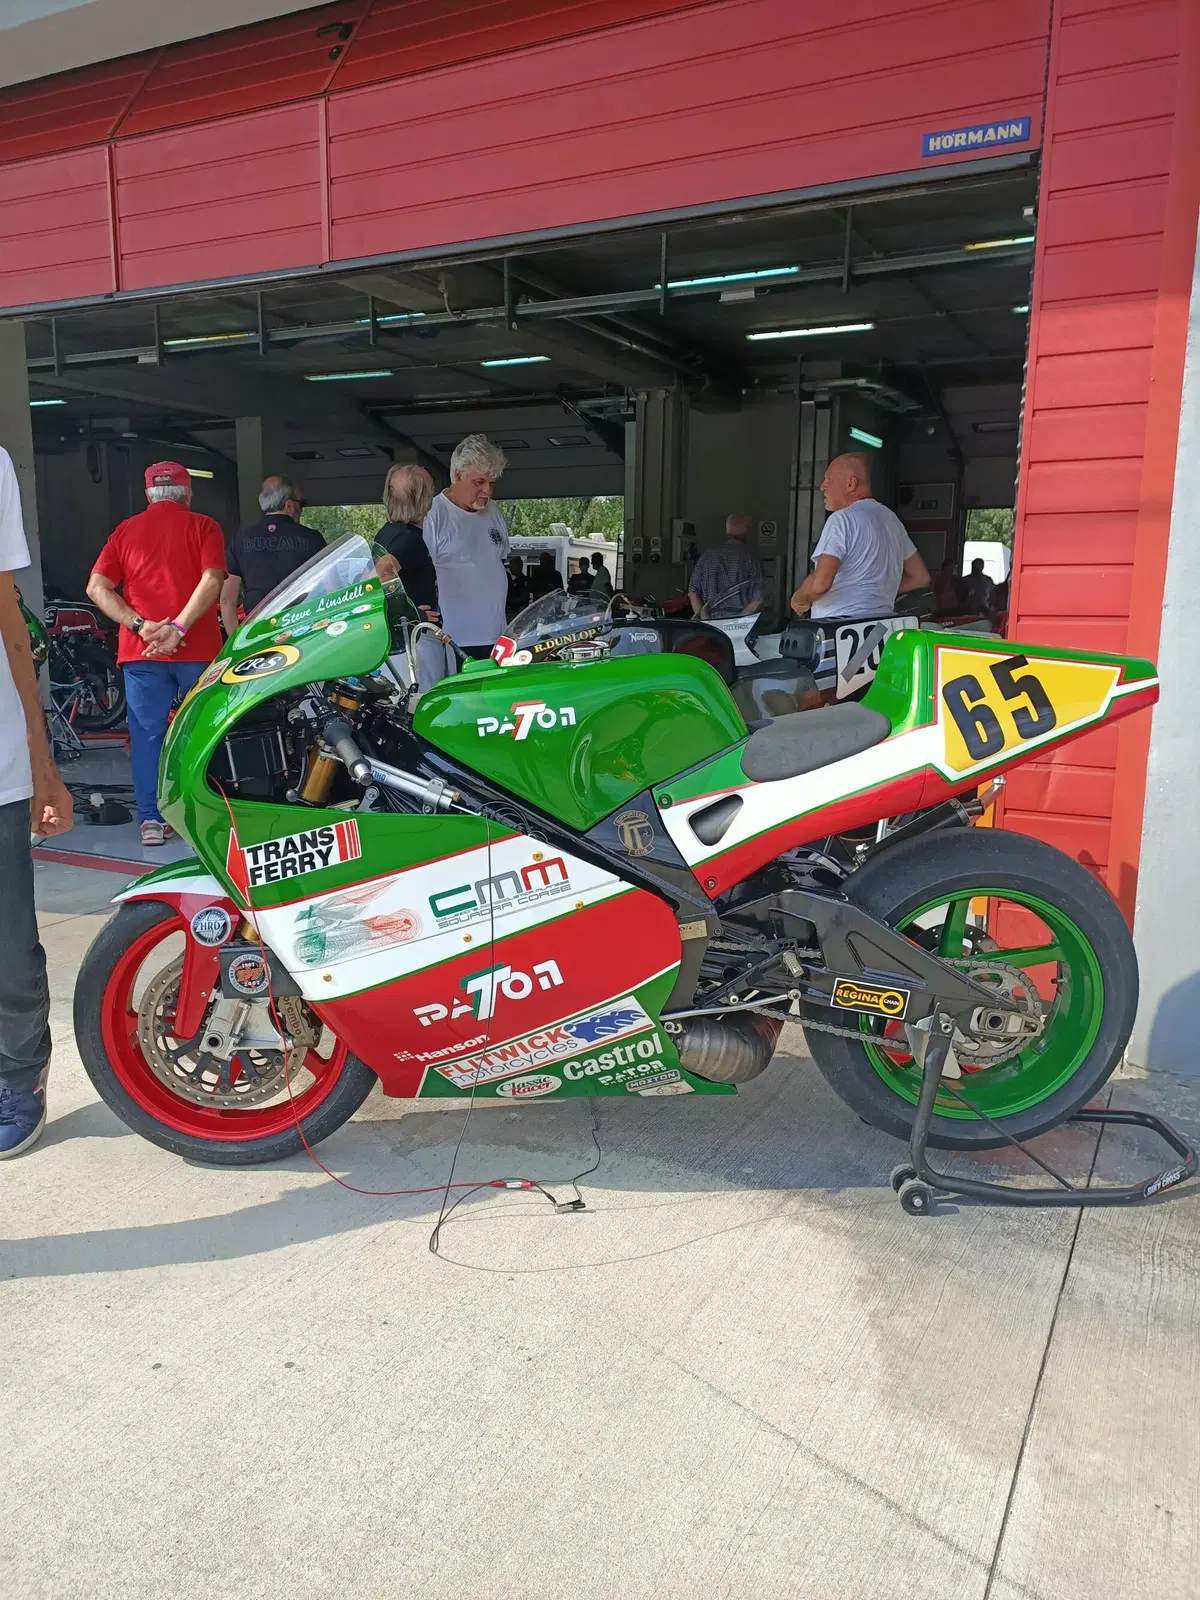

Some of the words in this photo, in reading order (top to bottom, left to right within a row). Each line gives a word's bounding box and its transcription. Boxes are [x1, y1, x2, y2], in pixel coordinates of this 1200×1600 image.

[281, 608, 312, 627] Steve
[316, 584, 364, 613] Linsdell
[533, 628, 597, 653] R.DUNLOP
[628, 632, 658, 643] Norton
[233, 656, 283, 673] CRS
[942, 654, 1057, 760] 65
[246, 826, 335, 866] TRANS
[249, 845, 334, 886] FERRY
[200, 921, 221, 931] HRD
[835, 988, 879, 1004] REGINA
[883, 998, 900, 1006] CHAIN
[414, 1034, 490, 1062] Hanson
[436, 1026, 571, 1077] FLITWICK
[563, 1032, 664, 1081] Castrol
[450, 1038, 578, 1084] motorcycles
[501, 1075, 551, 1093] Classic
[511, 1081, 552, 1096] Racer
[629, 1071, 676, 1088] MAXTON
